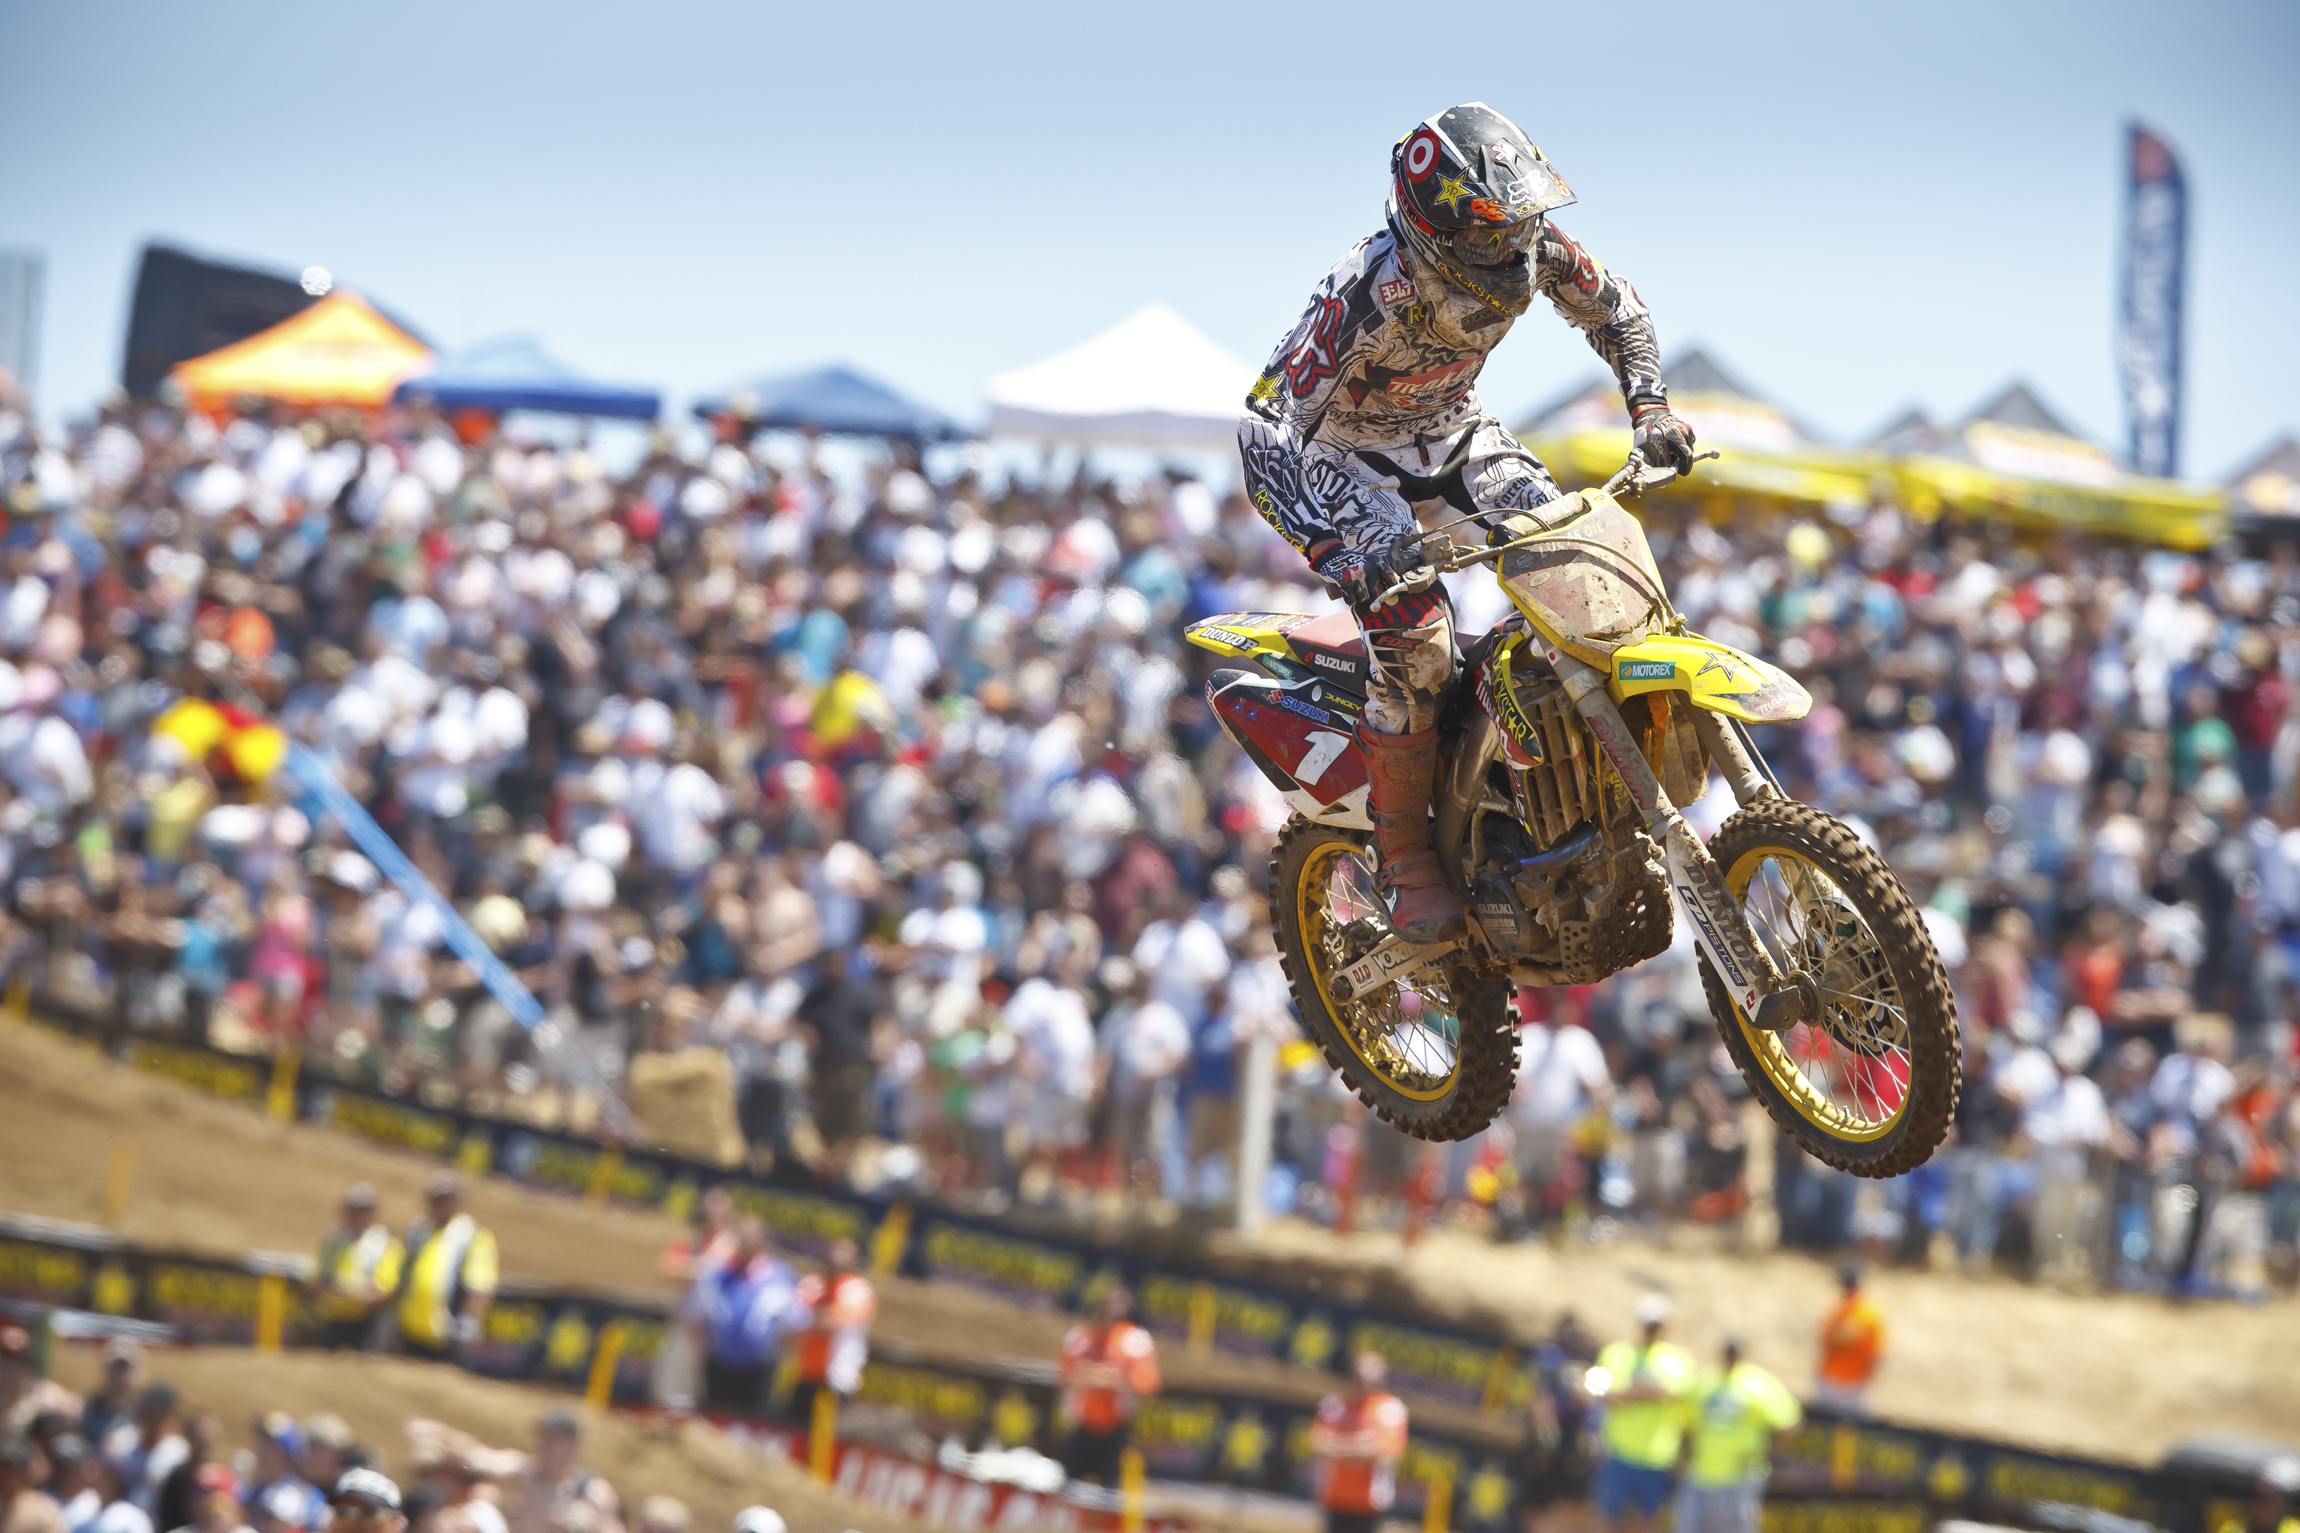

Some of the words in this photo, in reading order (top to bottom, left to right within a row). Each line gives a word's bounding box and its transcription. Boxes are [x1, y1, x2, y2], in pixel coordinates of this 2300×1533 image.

[1200, 626, 1259, 651] DUNLOP
[1376, 635, 1421, 650] FOX
[1314, 653, 1356, 674] SUZUKI
[1632, 664, 1672, 677] MOTOREX
[1281, 695, 1330, 723] SUZUKI
[1324, 692, 1363, 711] DUNGEY
[1294, 730, 1350, 787] 1
[1476, 903, 1515, 915] SUZUKI
[1683, 864, 1761, 977] DUNLOP
[1703, 923, 1745, 985] PISTONS
